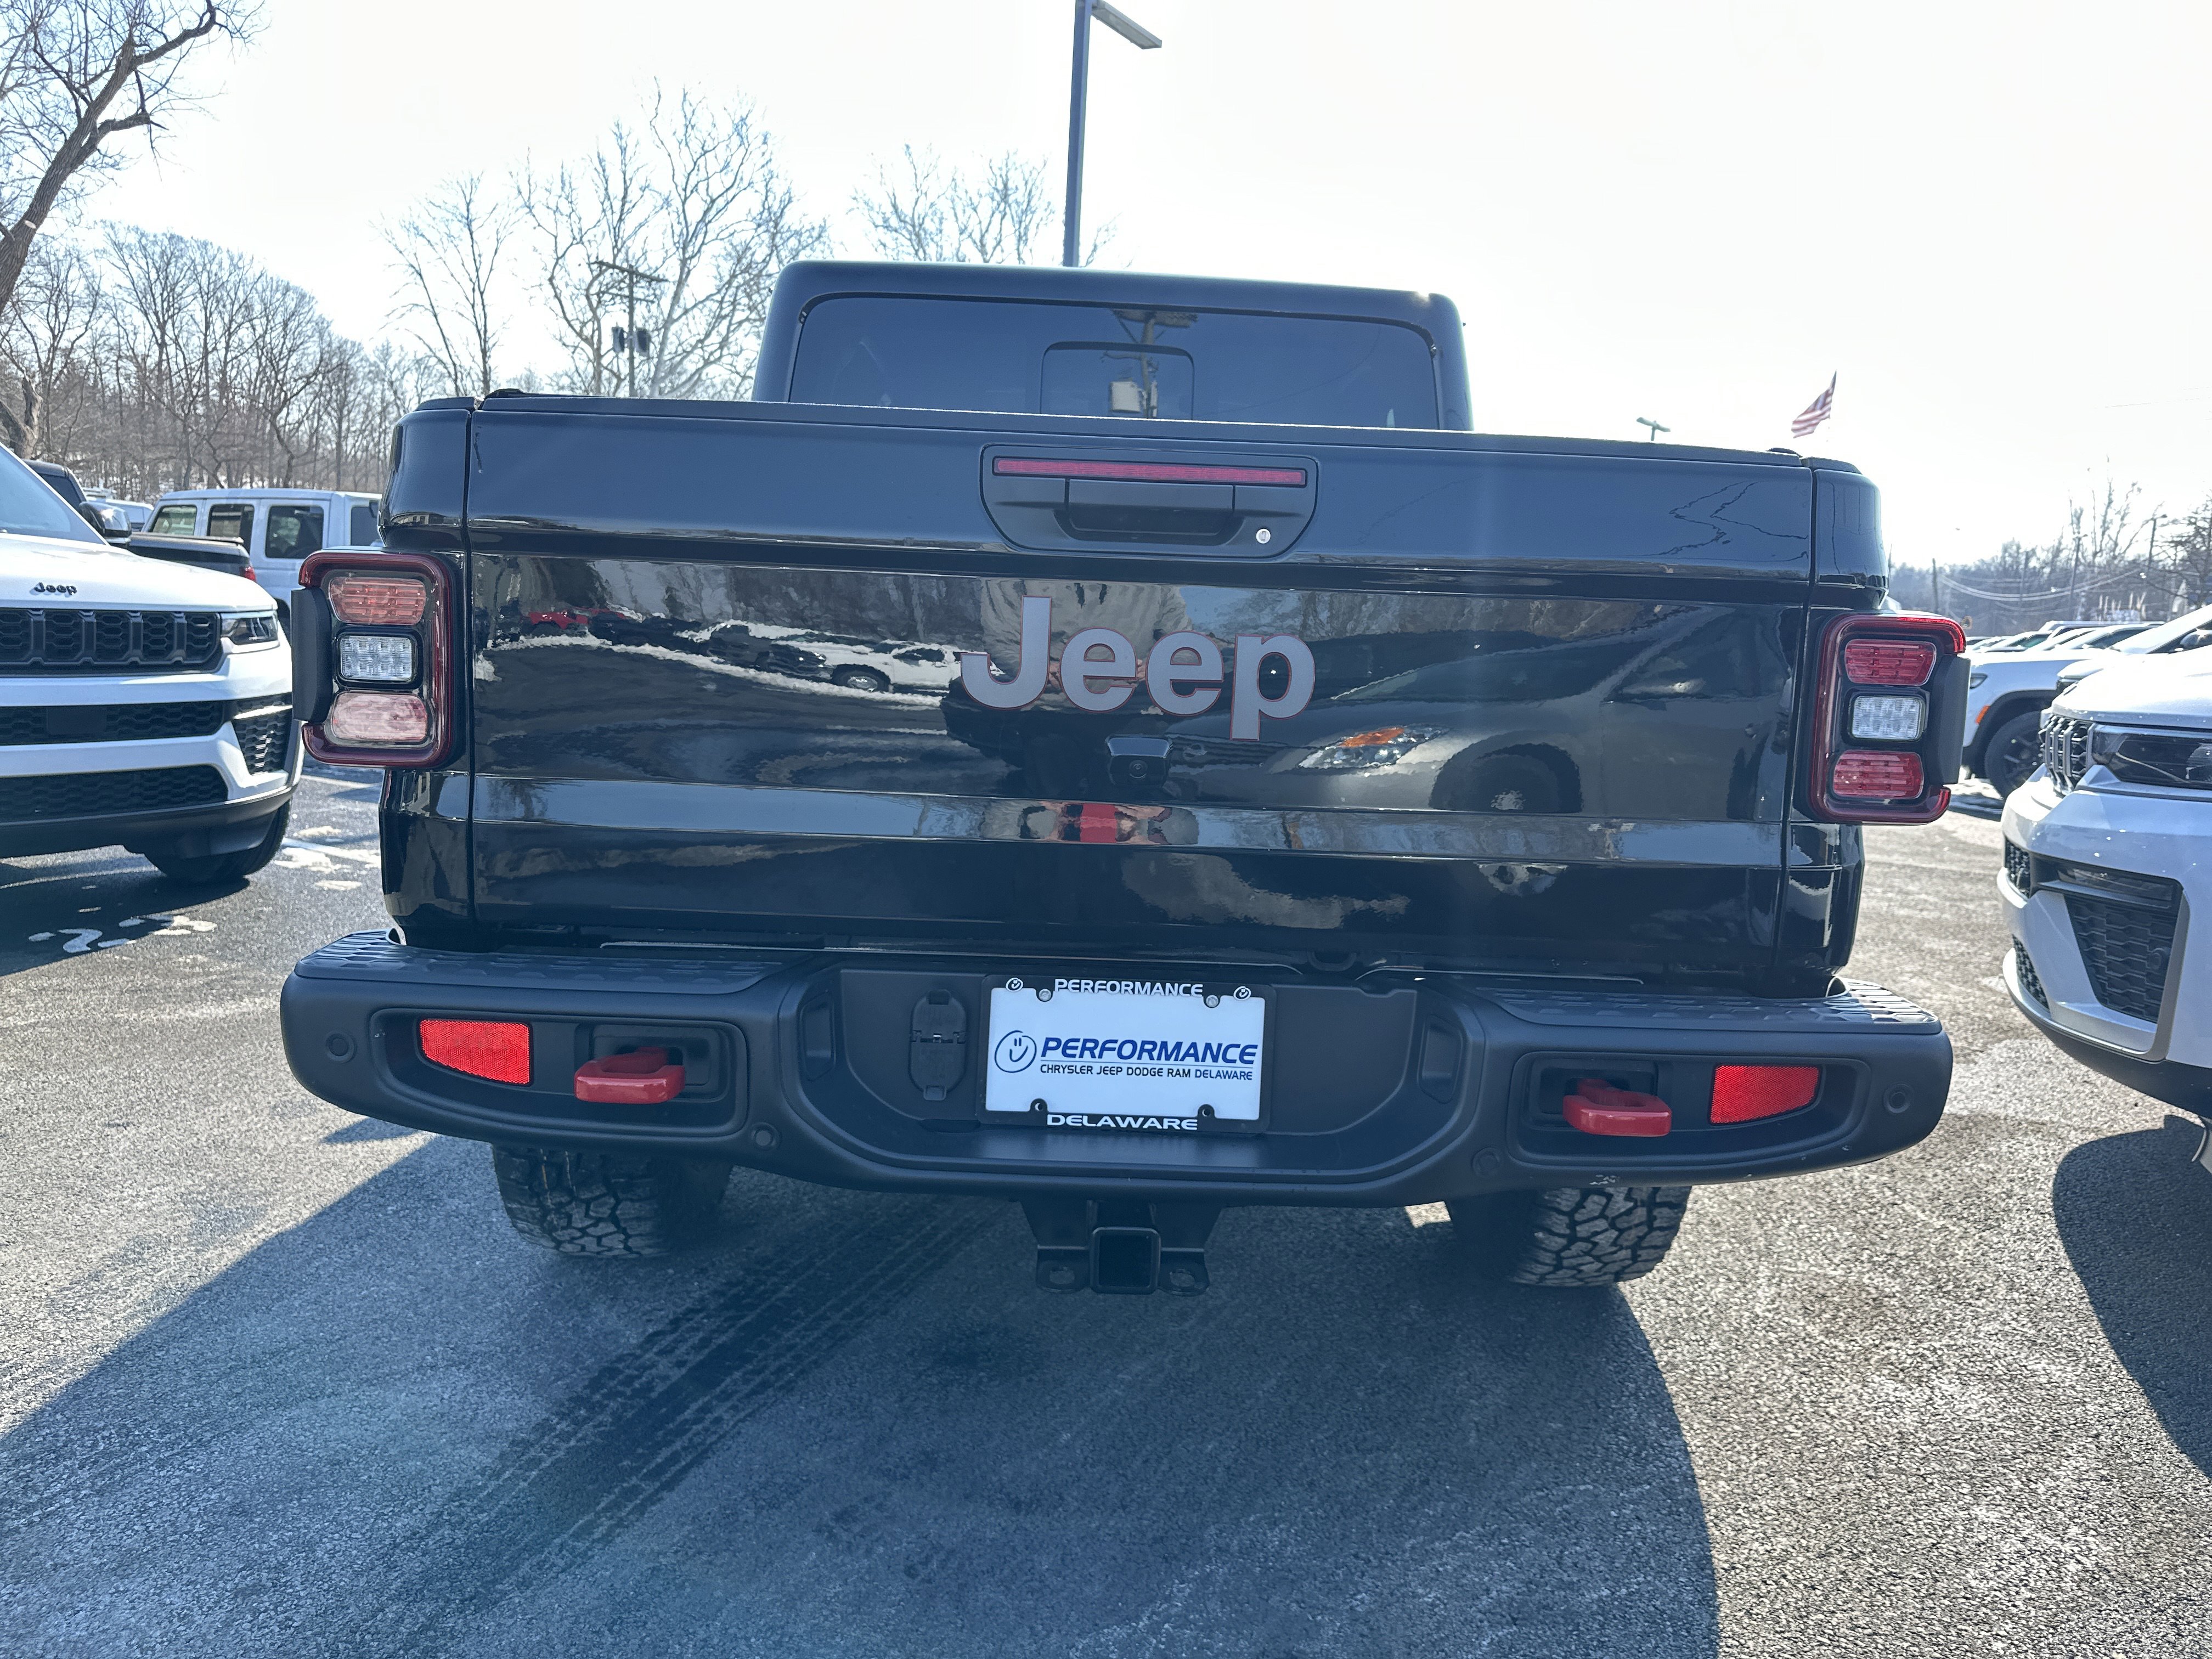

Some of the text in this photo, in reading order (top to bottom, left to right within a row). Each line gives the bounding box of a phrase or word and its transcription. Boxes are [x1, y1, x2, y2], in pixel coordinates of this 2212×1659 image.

[33, 582, 77, 595] Jeep
[961, 595, 1316, 741] Jeep
[1054, 978, 1204, 997] PERFORMANCE
[1041, 1037, 1258, 1065] PERFORMANCE
[1040, 1064, 1252, 1081] CHRYSLER JEEP DODGE RAM DELAWARE
[1047, 1114, 1198, 1131] DELAWARE
